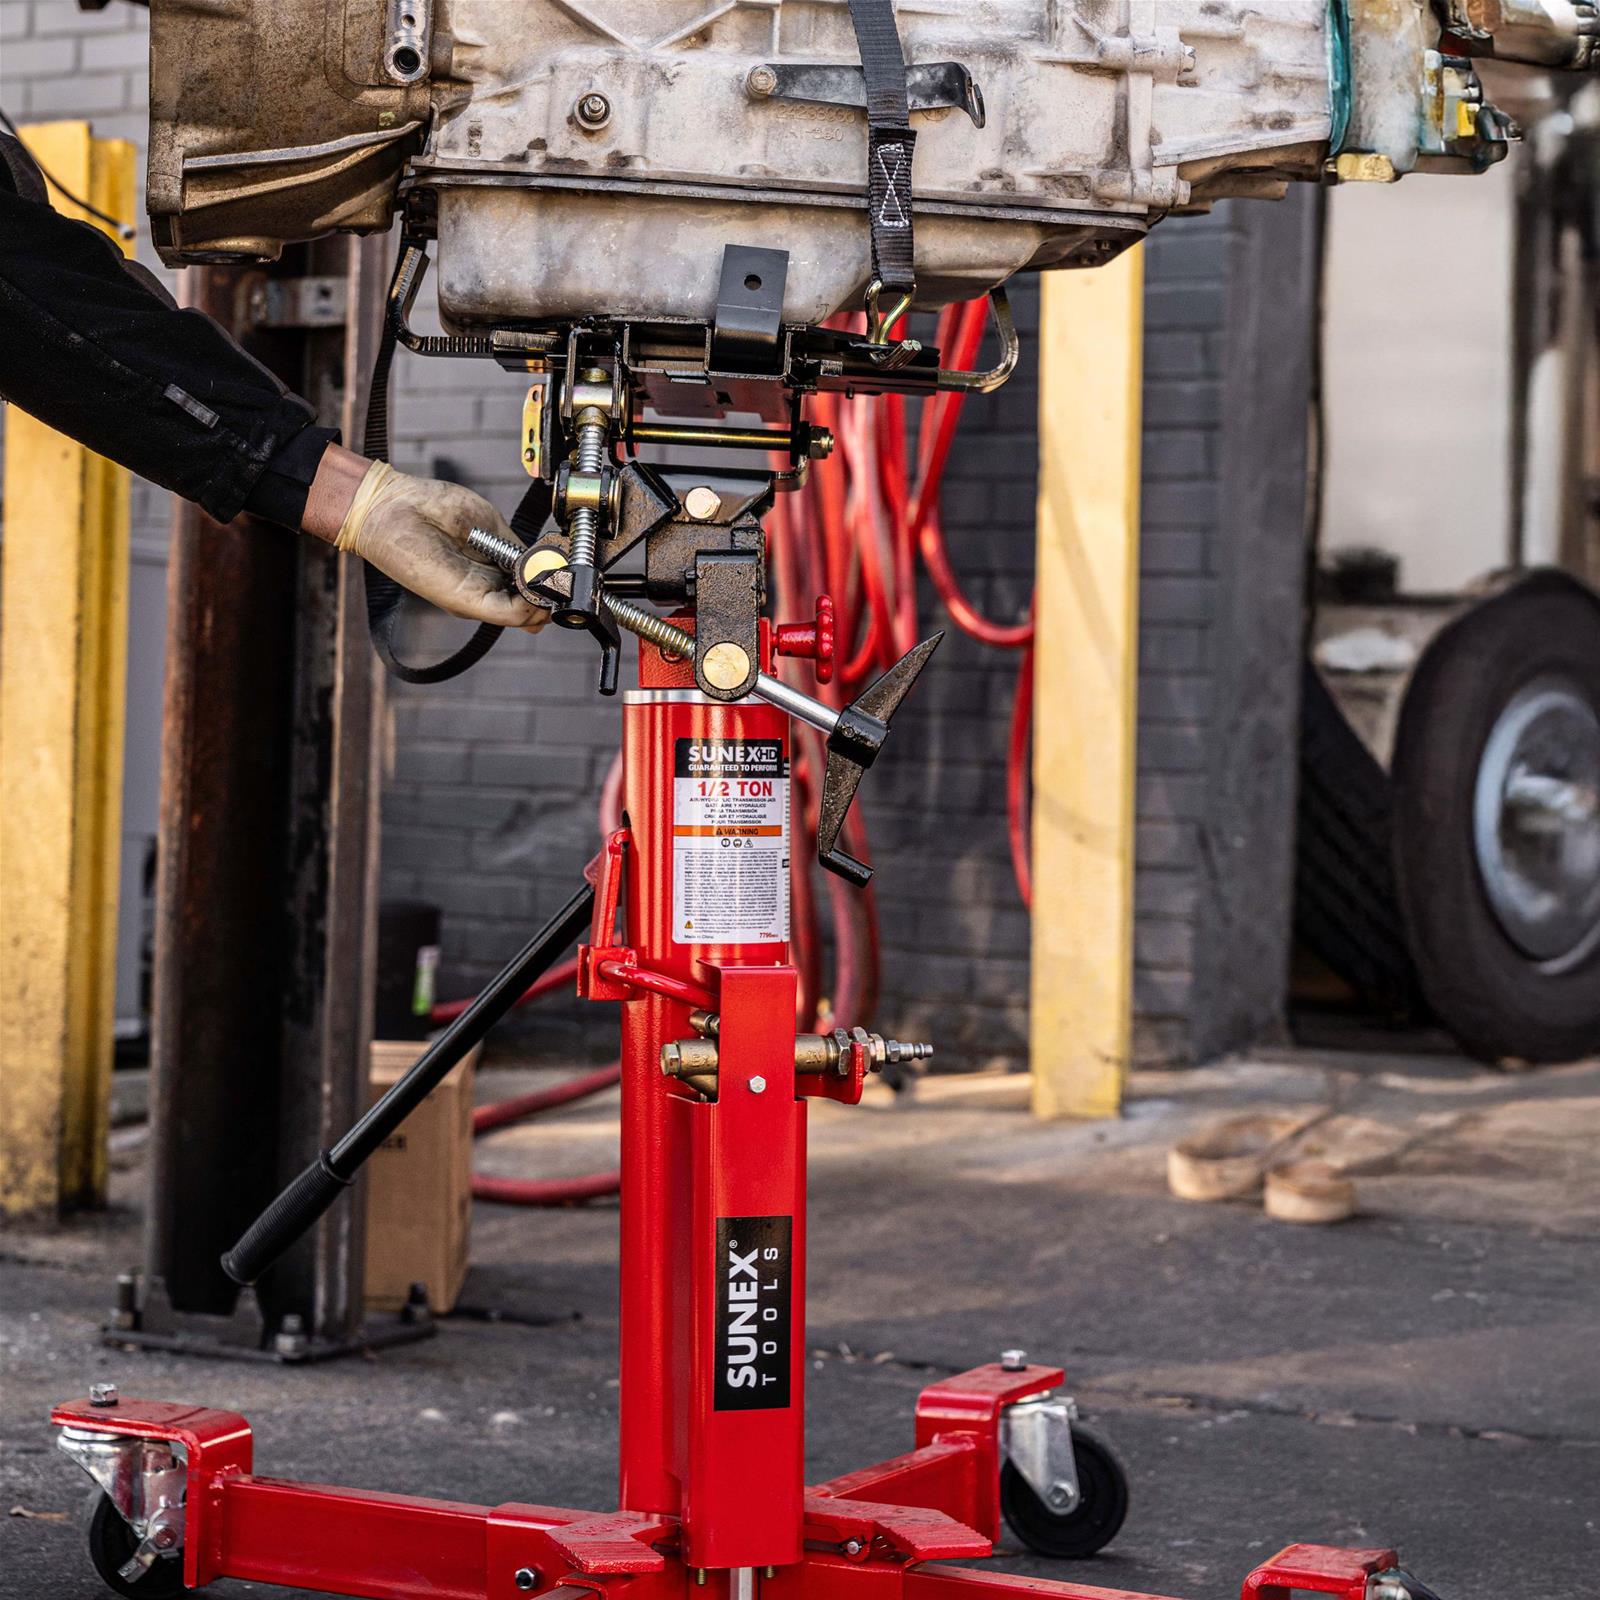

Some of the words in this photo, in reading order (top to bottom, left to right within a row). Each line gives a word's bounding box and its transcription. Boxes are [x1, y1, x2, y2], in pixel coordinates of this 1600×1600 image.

[698, 781, 729, 796] 1/2
[737, 781, 773, 796] TON
[762, 1247, 778, 1386] TOOLS
